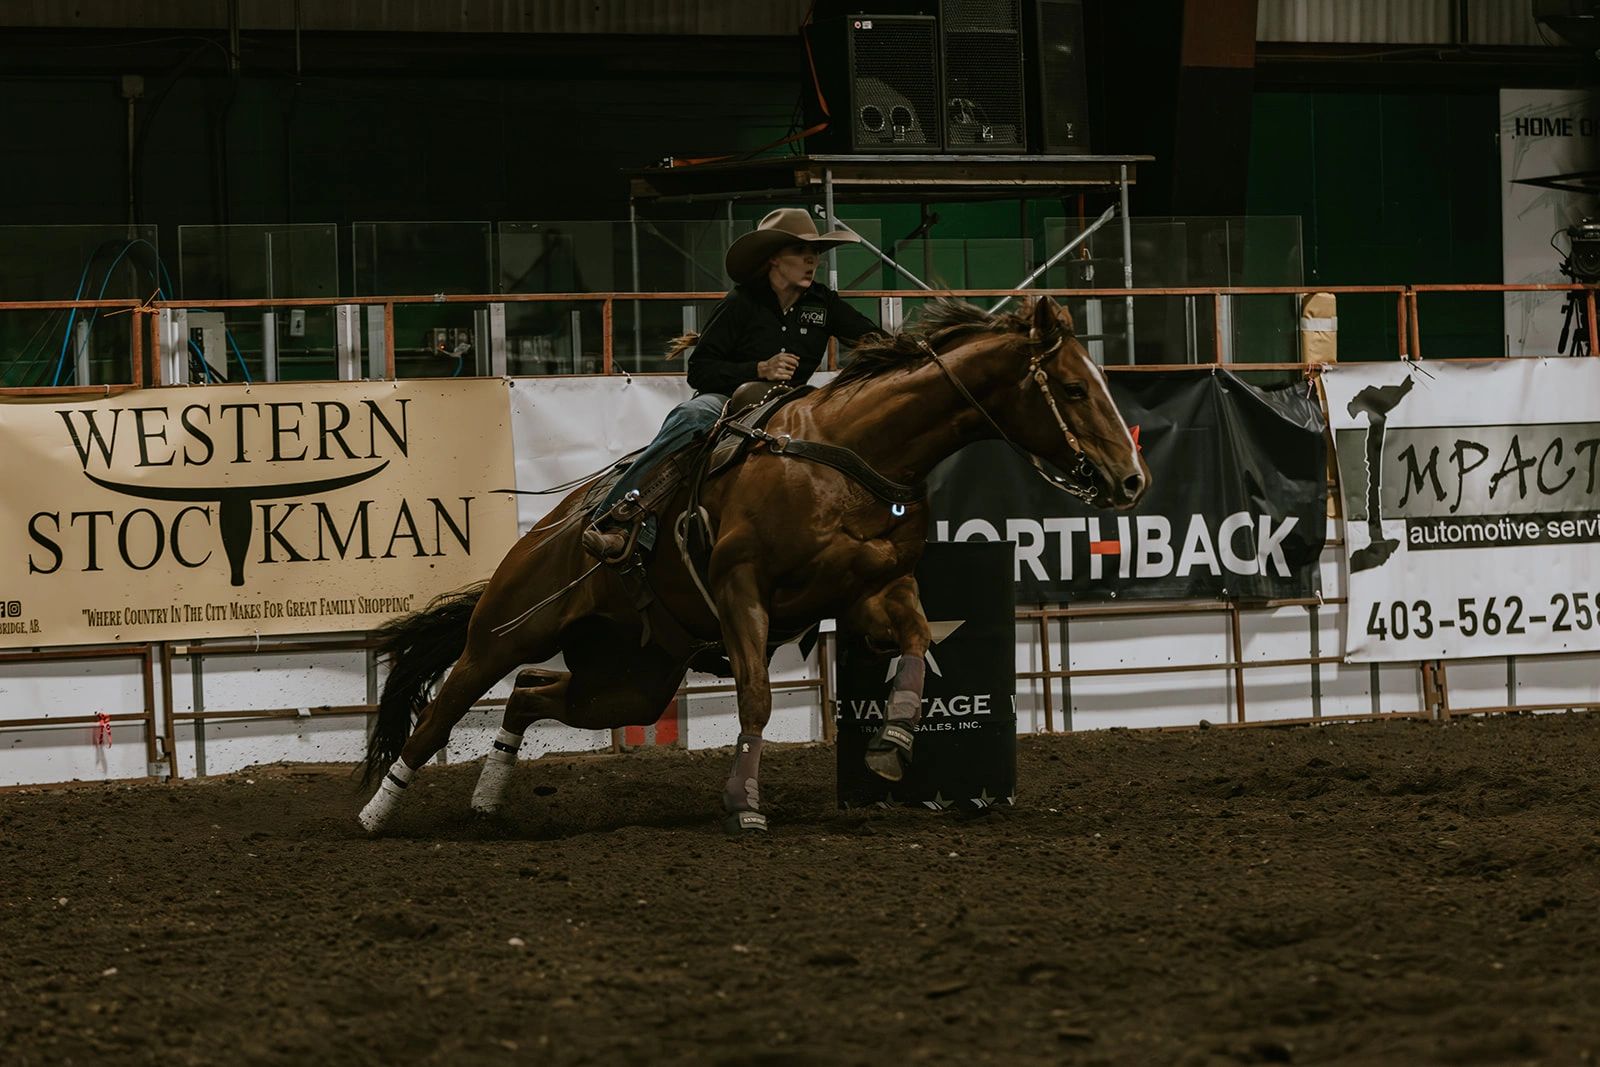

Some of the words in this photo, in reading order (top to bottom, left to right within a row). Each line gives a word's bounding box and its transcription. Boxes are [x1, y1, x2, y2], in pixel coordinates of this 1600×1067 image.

[1515, 117, 1573, 137] HOME
[55, 398, 411, 471] WESTERN
[28, 496, 476, 576] STOCKMAN
[936, 511, 1300, 582] RTHBACK
[1410, 520, 1540, 545] automotive
[82, 608, 122, 627] "WHERE
[124, 606, 168, 625] COUNTRY
[171, 604, 182, 623] IN
[183, 604, 203, 622] THE
[205, 602, 227, 621] CITY
[230, 601, 261, 620] MAKES
[264, 600, 284, 618] FOR
[286, 599, 317, 617] GREAT
[320, 597, 356, 616] FAMILY
[358, 594, 414, 614] SHOPPING"
[850, 694, 991, 720] VAAGE
[959, 720, 982, 730] INC.
